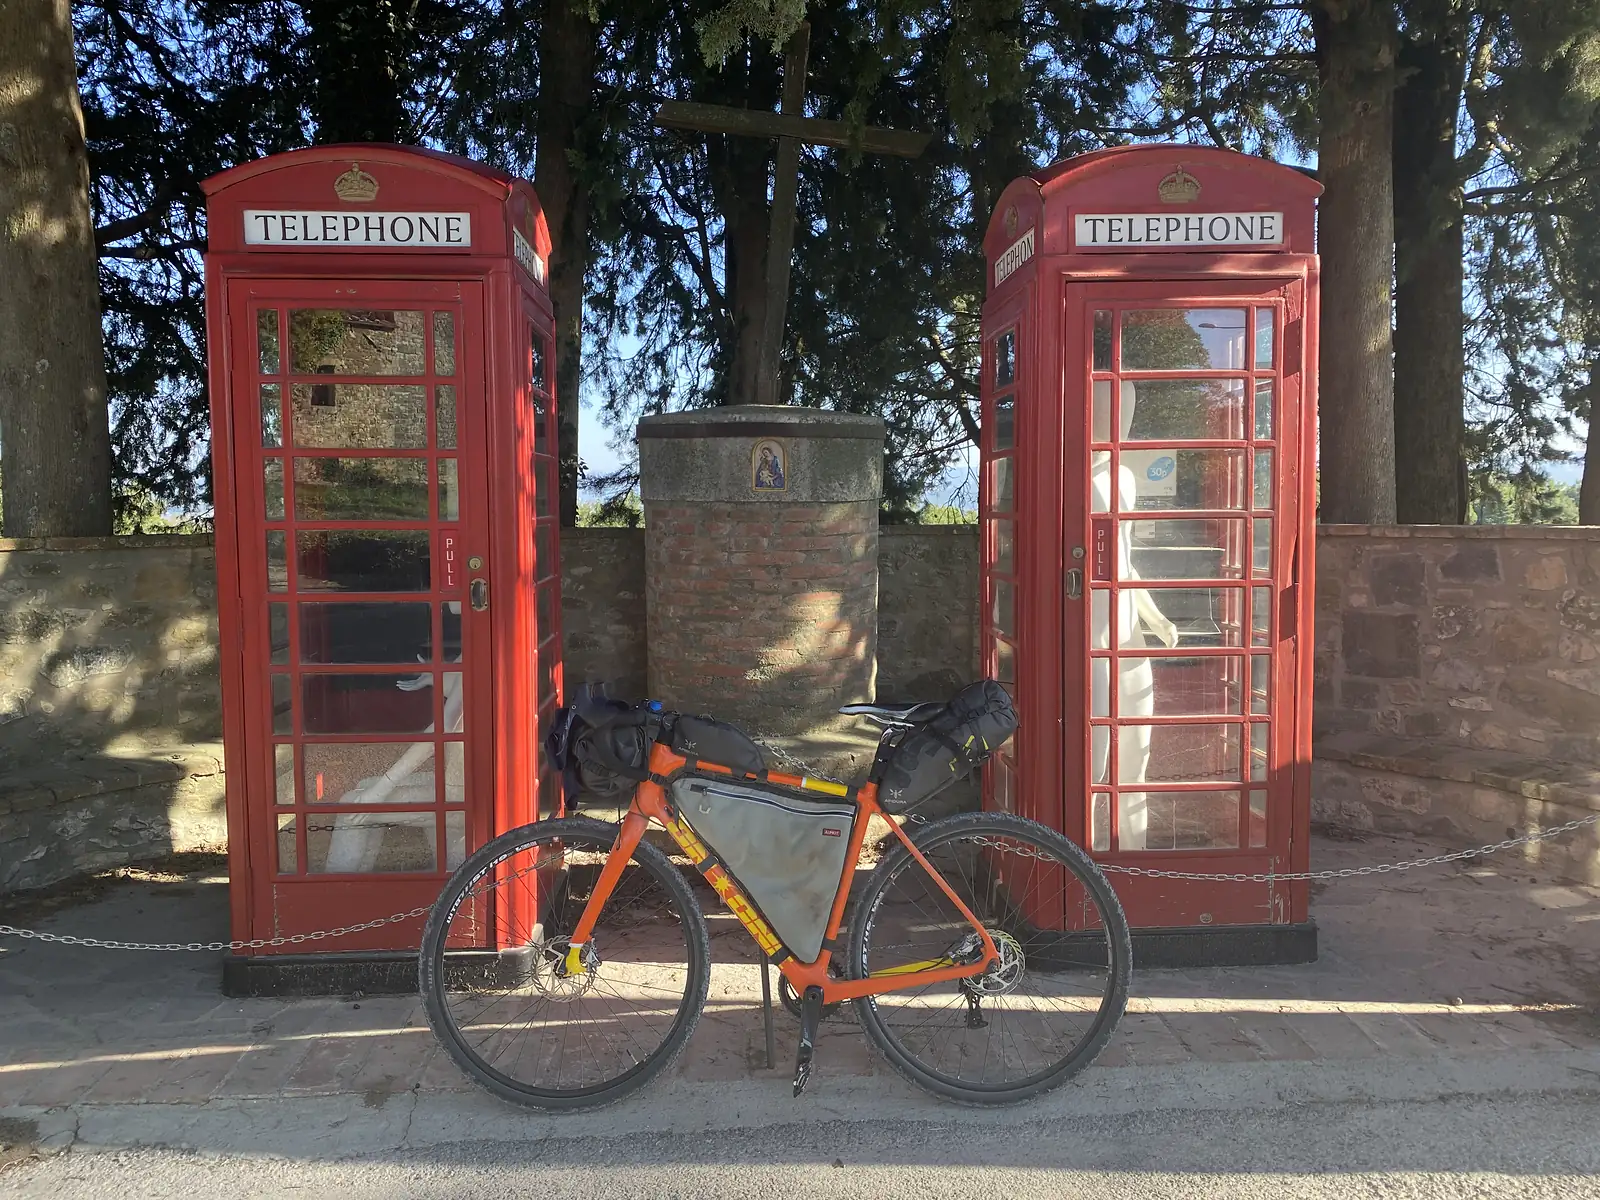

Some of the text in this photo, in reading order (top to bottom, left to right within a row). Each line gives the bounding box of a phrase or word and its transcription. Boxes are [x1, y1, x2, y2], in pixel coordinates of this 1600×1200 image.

[254, 214, 463, 243] TELEPHONE
[1084, 215, 1275, 243] TELEPHONE
[1150, 467, 1167, 478] 30p
[446, 538, 454, 585] PULL
[1097, 529, 1105, 576] PULL
